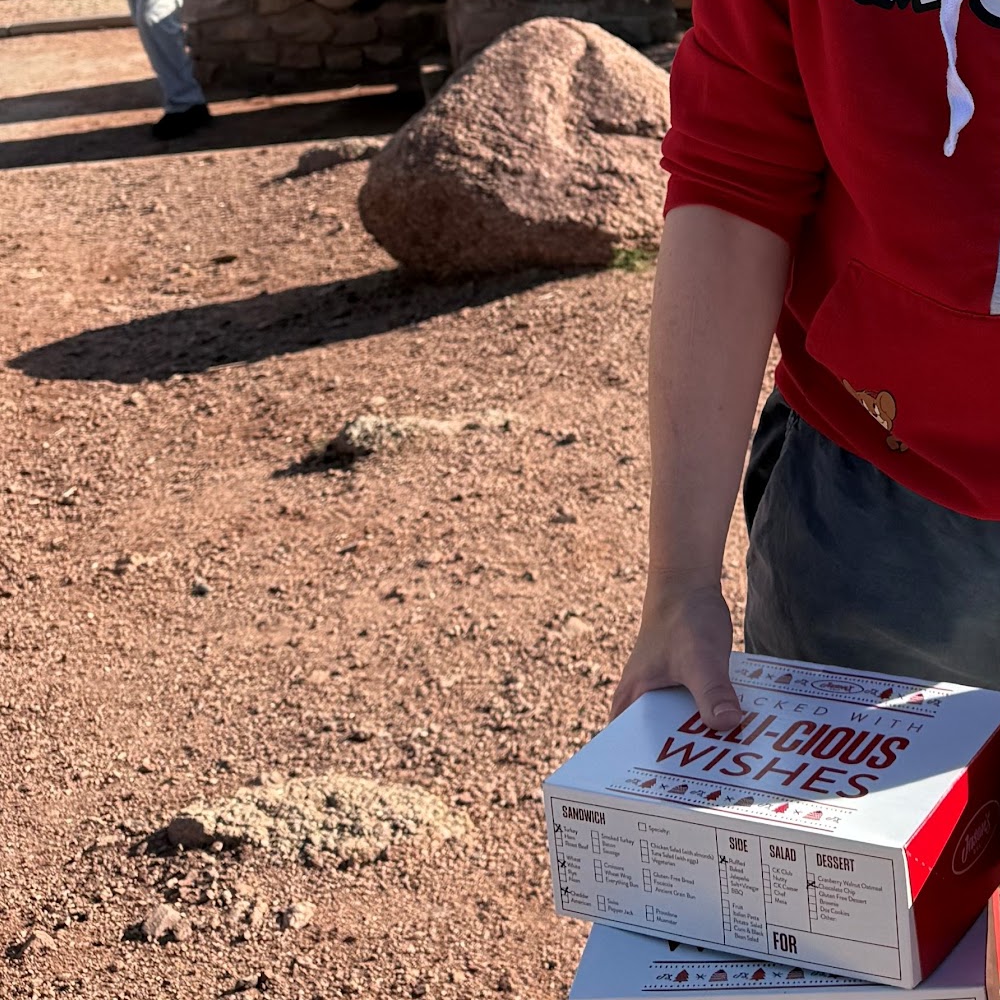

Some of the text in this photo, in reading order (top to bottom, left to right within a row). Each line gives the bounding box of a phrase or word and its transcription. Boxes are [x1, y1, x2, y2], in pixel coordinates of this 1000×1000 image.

[850, 712, 924, 733] WITH
[655, 736, 879, 799] WISHES
[562, 805, 606, 825] SANDWICH
[729, 836, 749, 853] SIDE
[769, 844, 797, 862] SALAD
[816, 853, 855, 872] DESSERT
[772, 931, 798, 954] FOR
